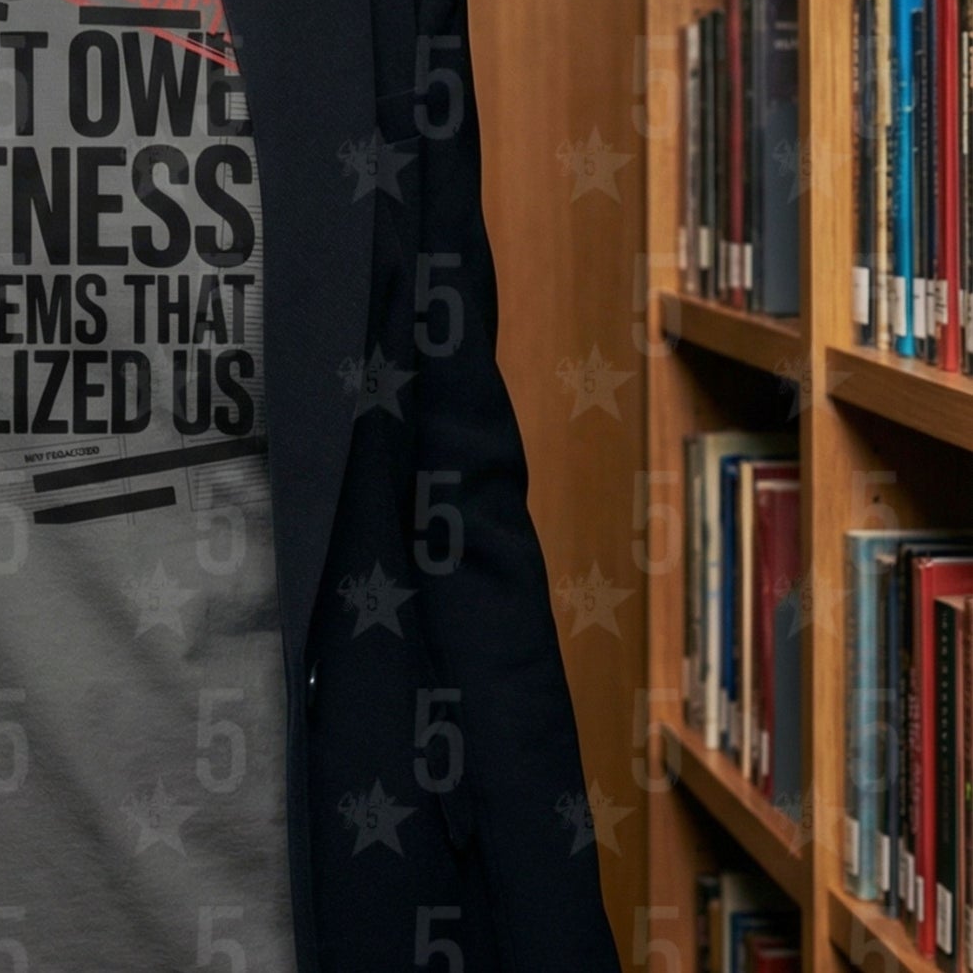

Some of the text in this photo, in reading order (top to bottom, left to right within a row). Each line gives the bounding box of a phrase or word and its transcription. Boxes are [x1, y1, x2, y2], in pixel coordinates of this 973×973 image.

[68, 29, 254, 137] OWE
[124, 273, 255, 345] THAT
[172, 349, 255, 435] US
